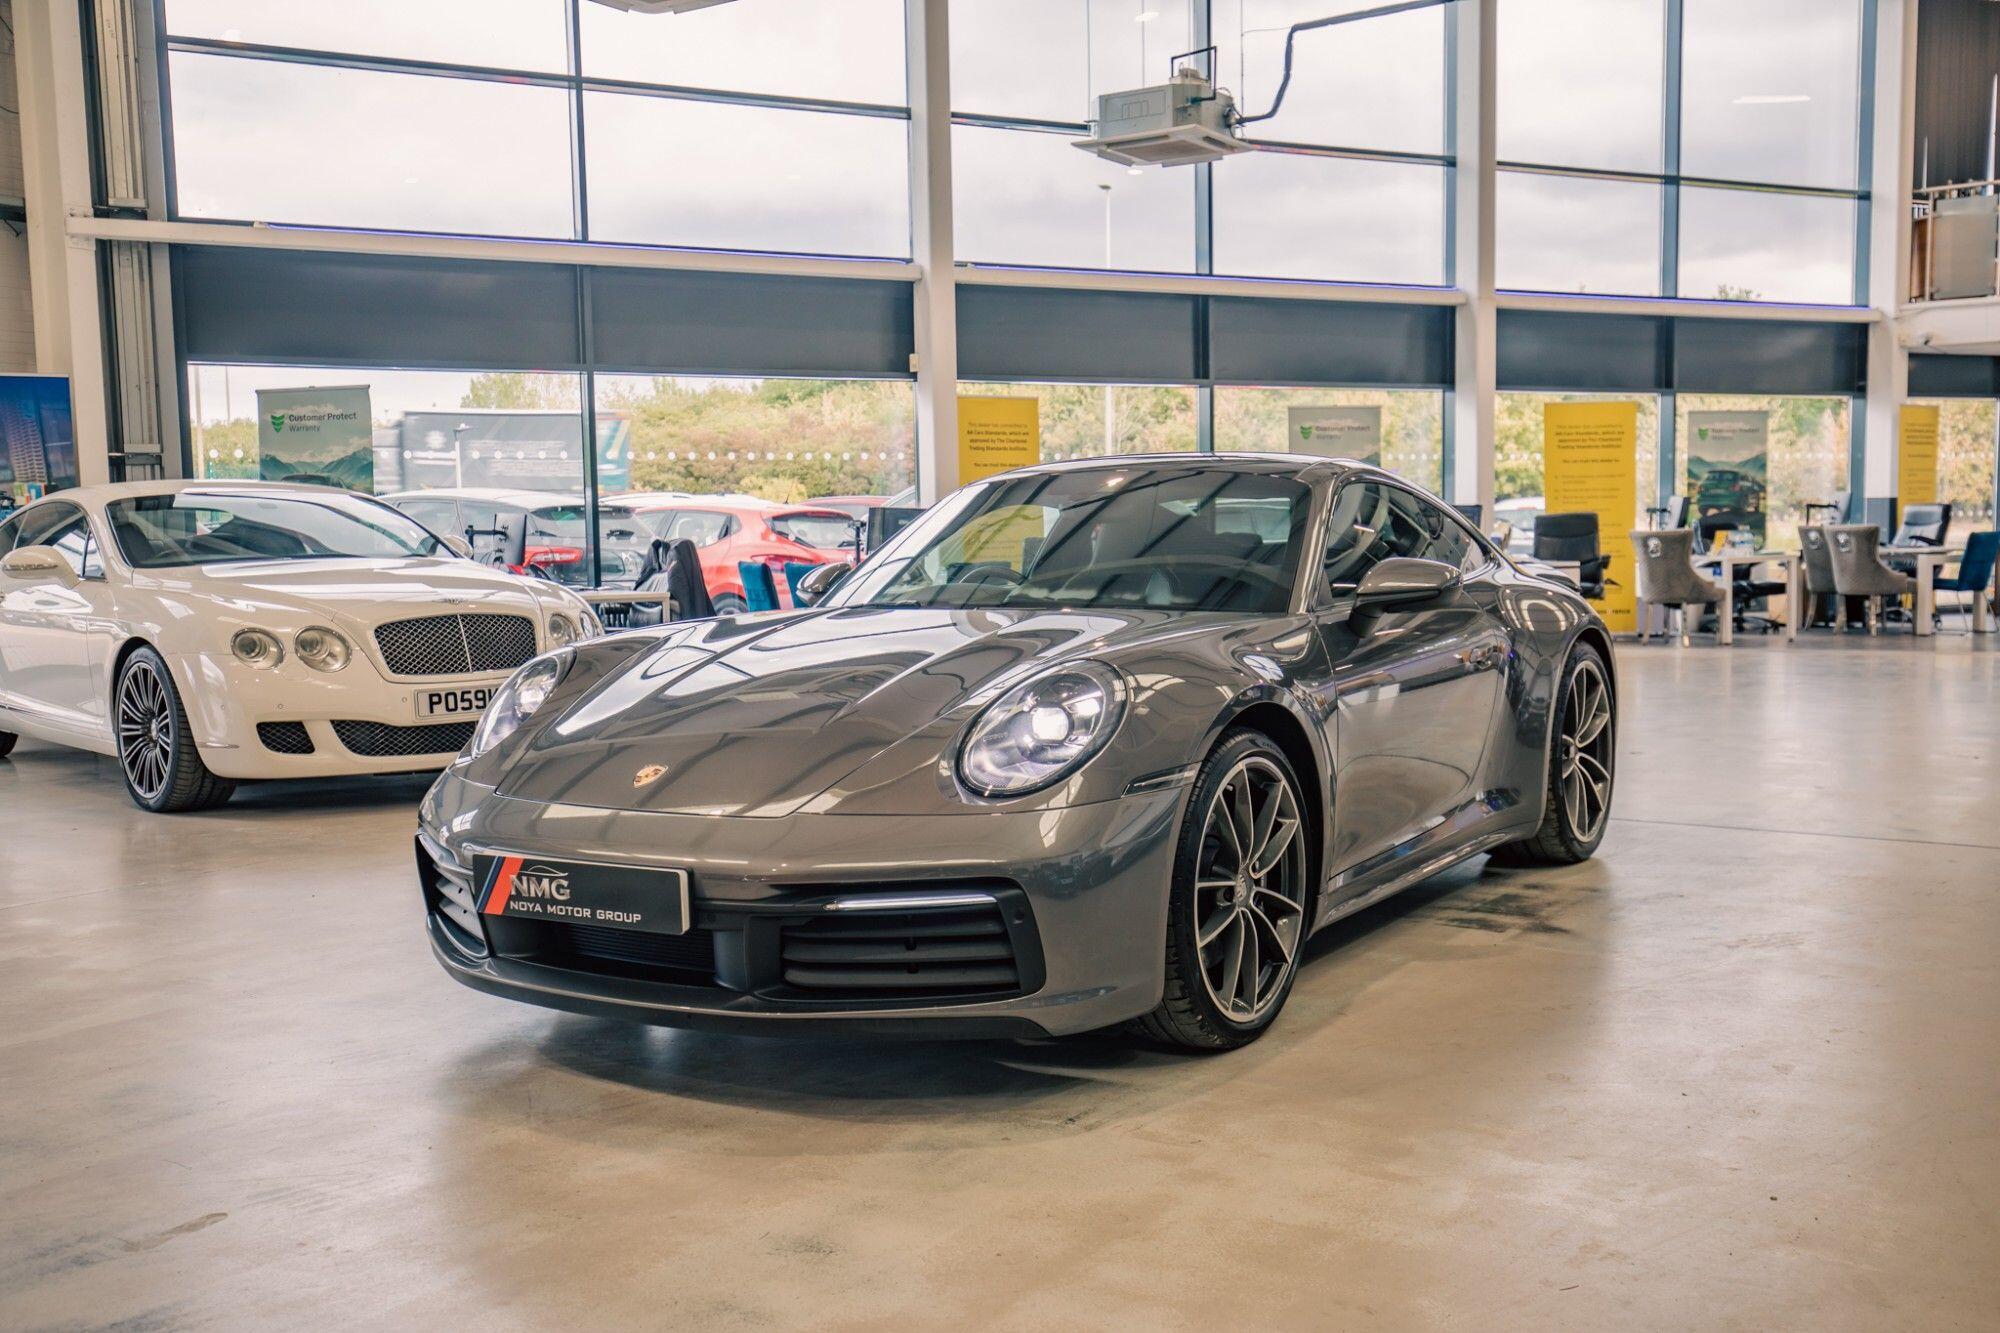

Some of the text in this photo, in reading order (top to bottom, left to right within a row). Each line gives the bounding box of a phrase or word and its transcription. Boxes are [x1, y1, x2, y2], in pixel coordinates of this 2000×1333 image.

[288, 412, 357, 422] Customer Protect
[509, 875, 571, 900] NMG
[510, 901, 642, 923] NOYA MOTOR GROUP
